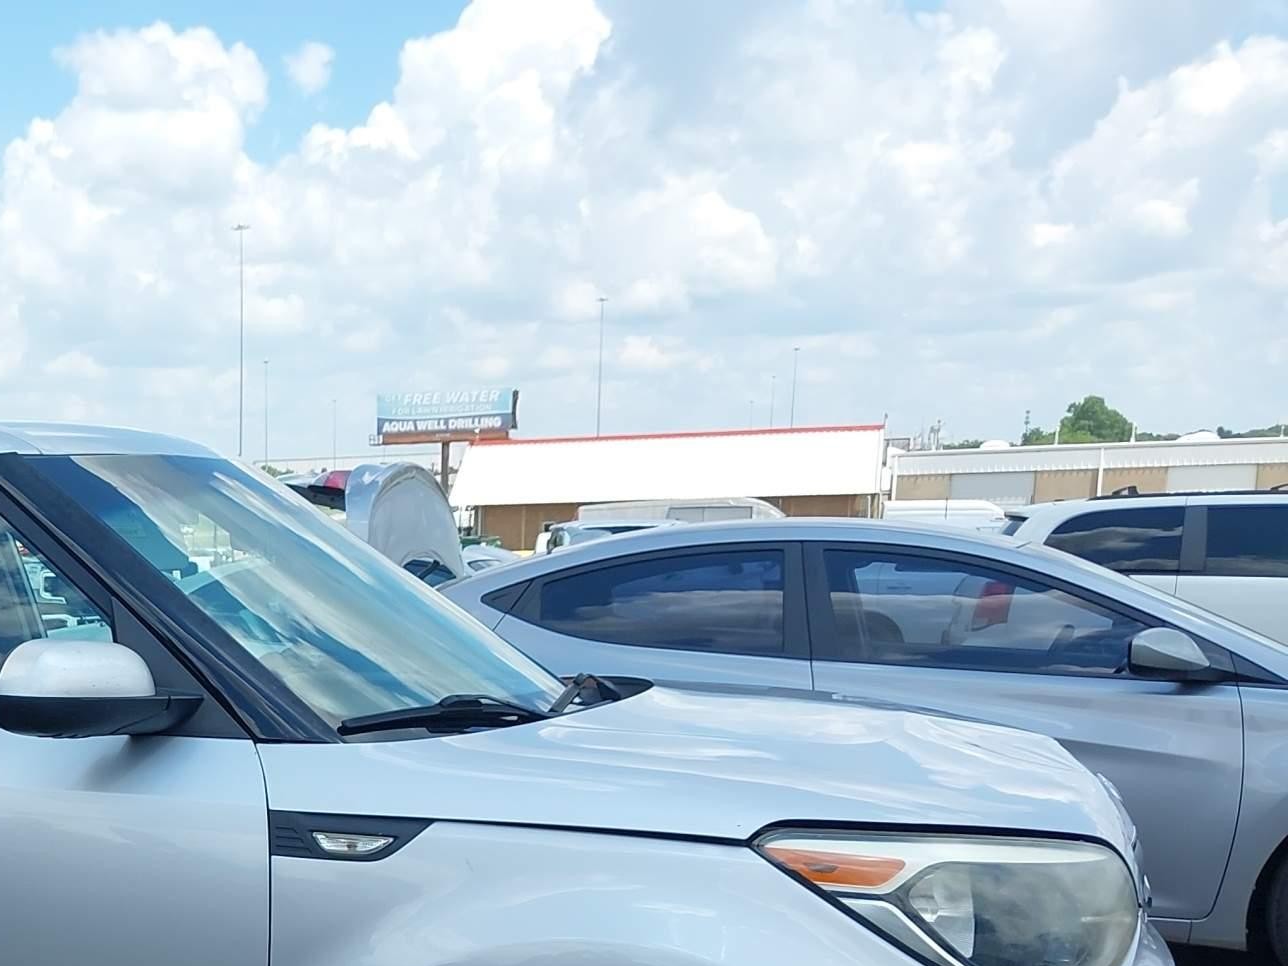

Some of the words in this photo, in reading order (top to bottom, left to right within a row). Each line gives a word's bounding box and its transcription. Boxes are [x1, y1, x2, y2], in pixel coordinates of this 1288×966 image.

[403, 391, 441, 406] FREE
[445, 389, 500, 404] WATER
[382, 420, 415, 433] AQUA
[416, 418, 447, 431] WELL
[448, 416, 502, 430] DRILLING
